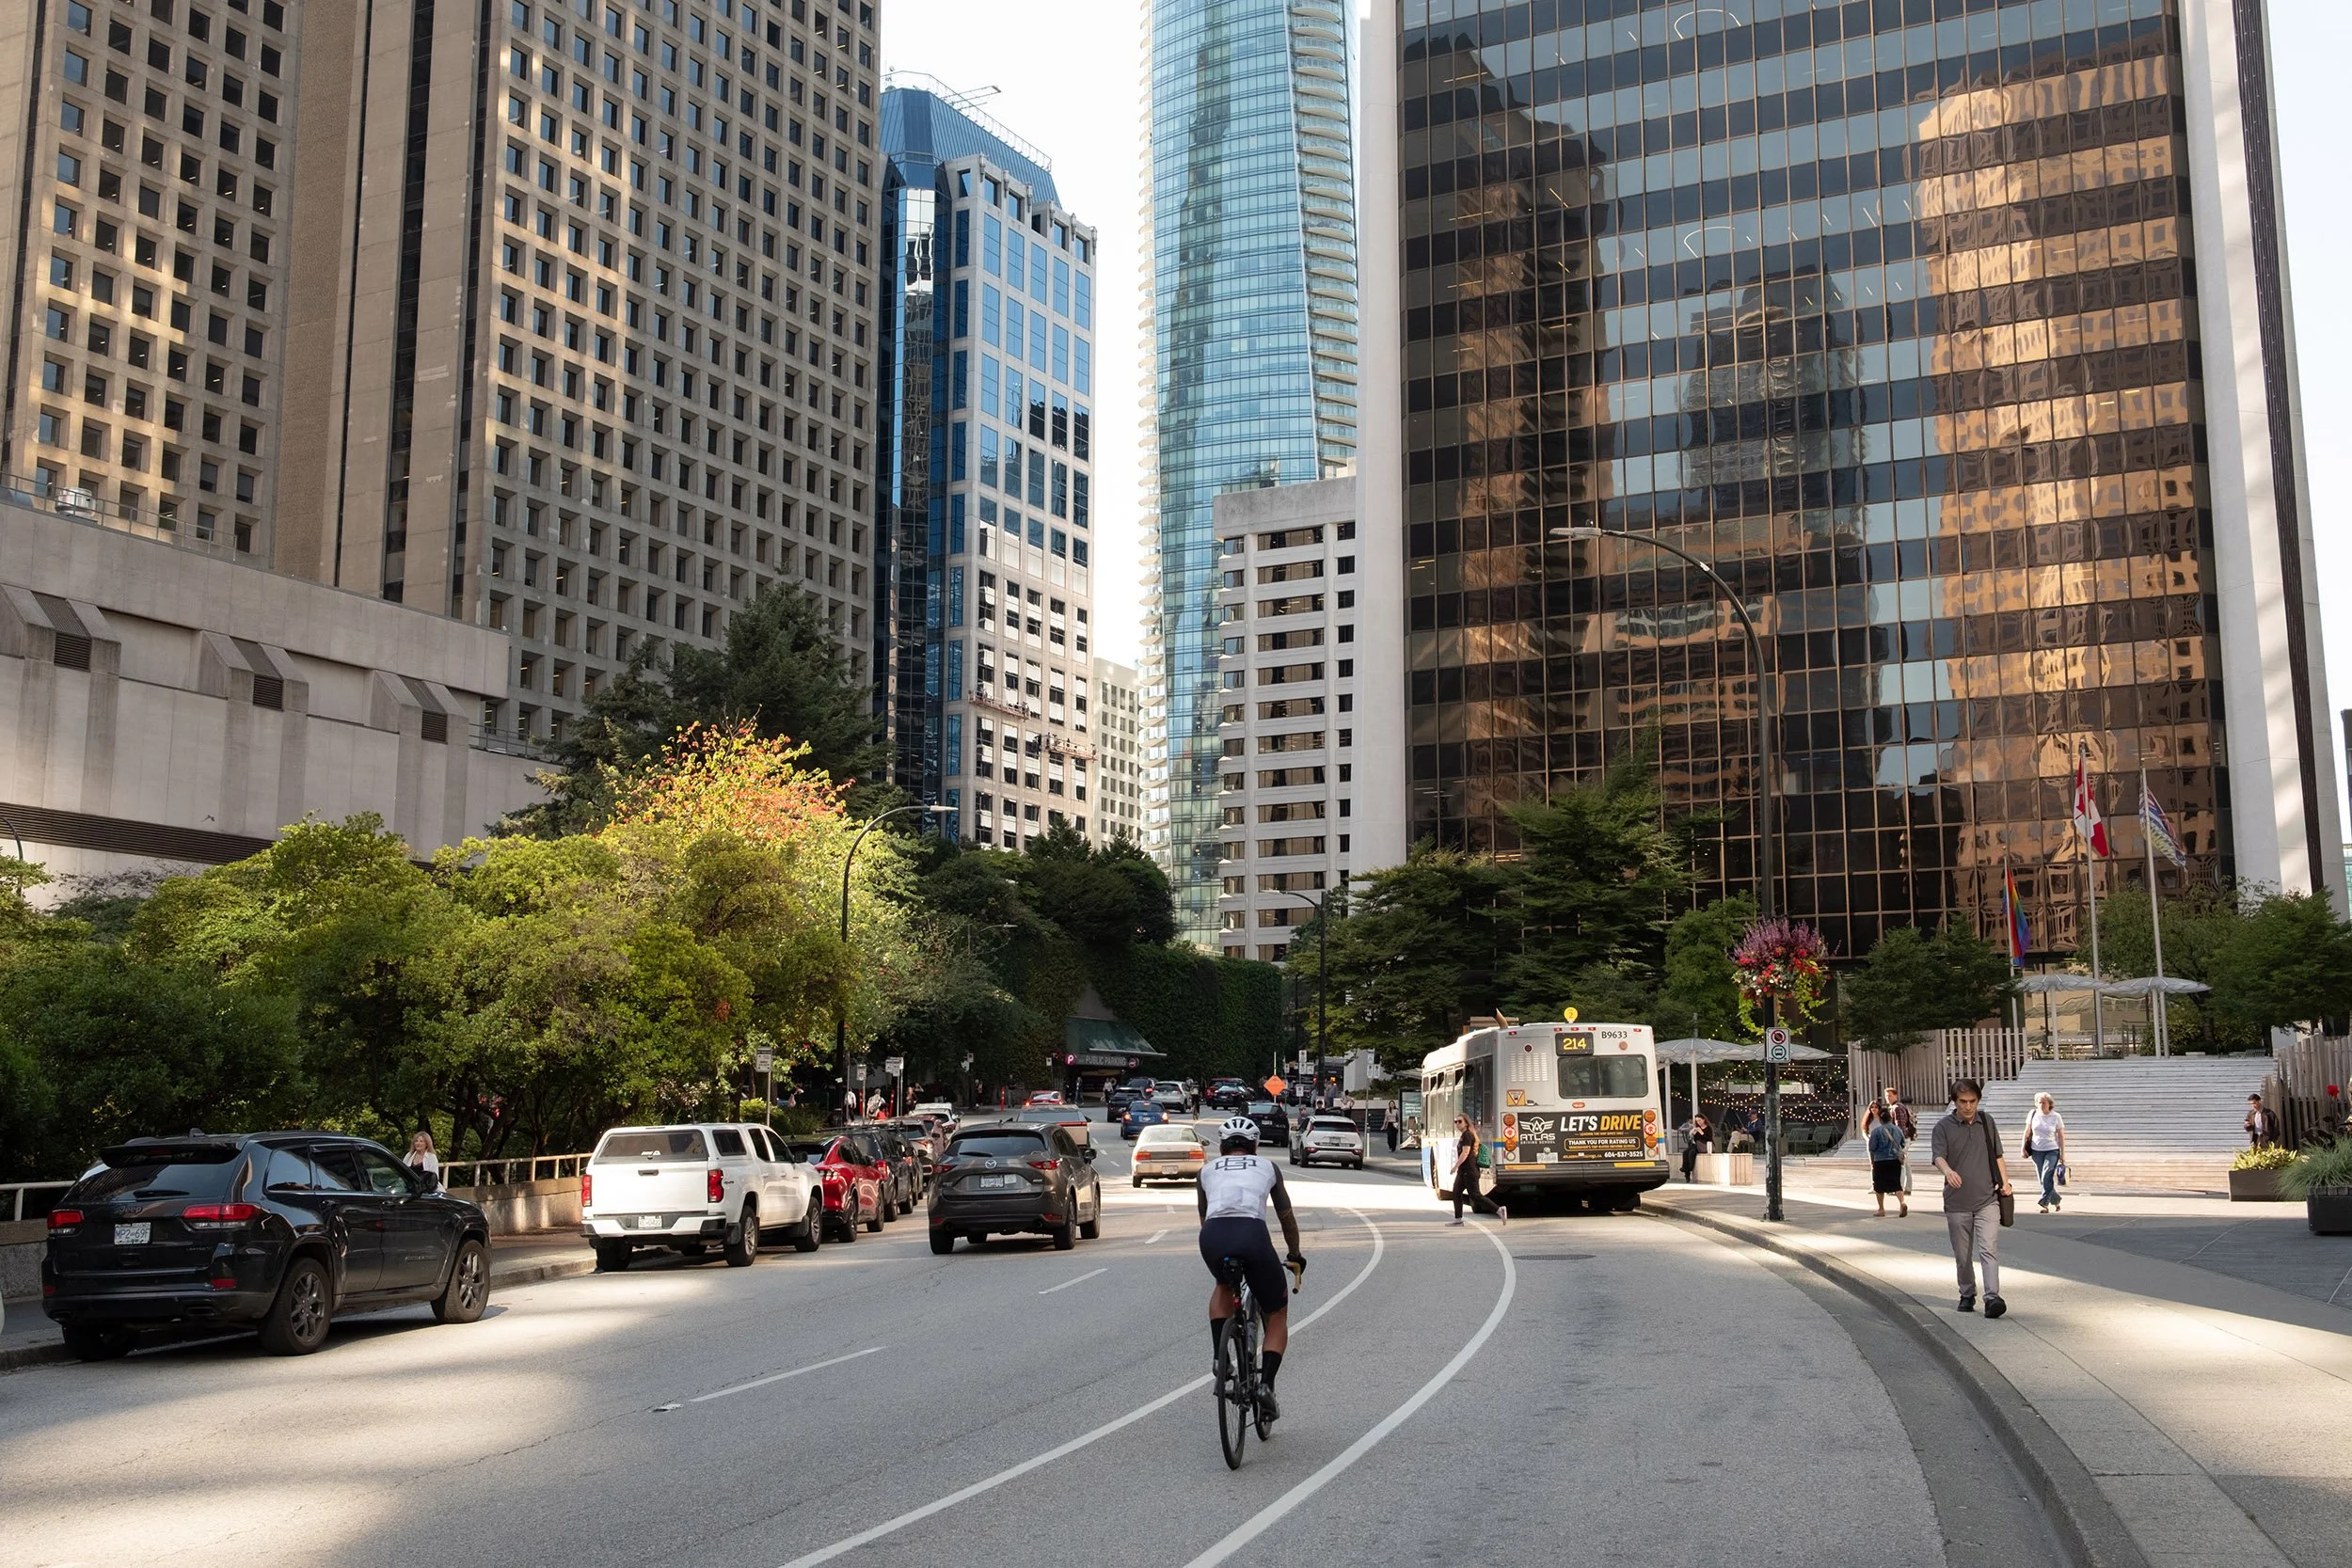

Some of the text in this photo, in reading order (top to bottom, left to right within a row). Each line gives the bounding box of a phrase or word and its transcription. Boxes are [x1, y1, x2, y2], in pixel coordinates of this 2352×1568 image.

[1601, 1031, 1628, 1039] B9633
[1563, 1037, 1587, 1050] 214
[1085, 1055, 1127, 1066] PUBLIC PARKING
[1560, 1115, 1642, 1132] LET'S DRIVE
[1520, 1132, 1555, 1141] ATLAS
[120, 1205, 143, 1213] Jeep
